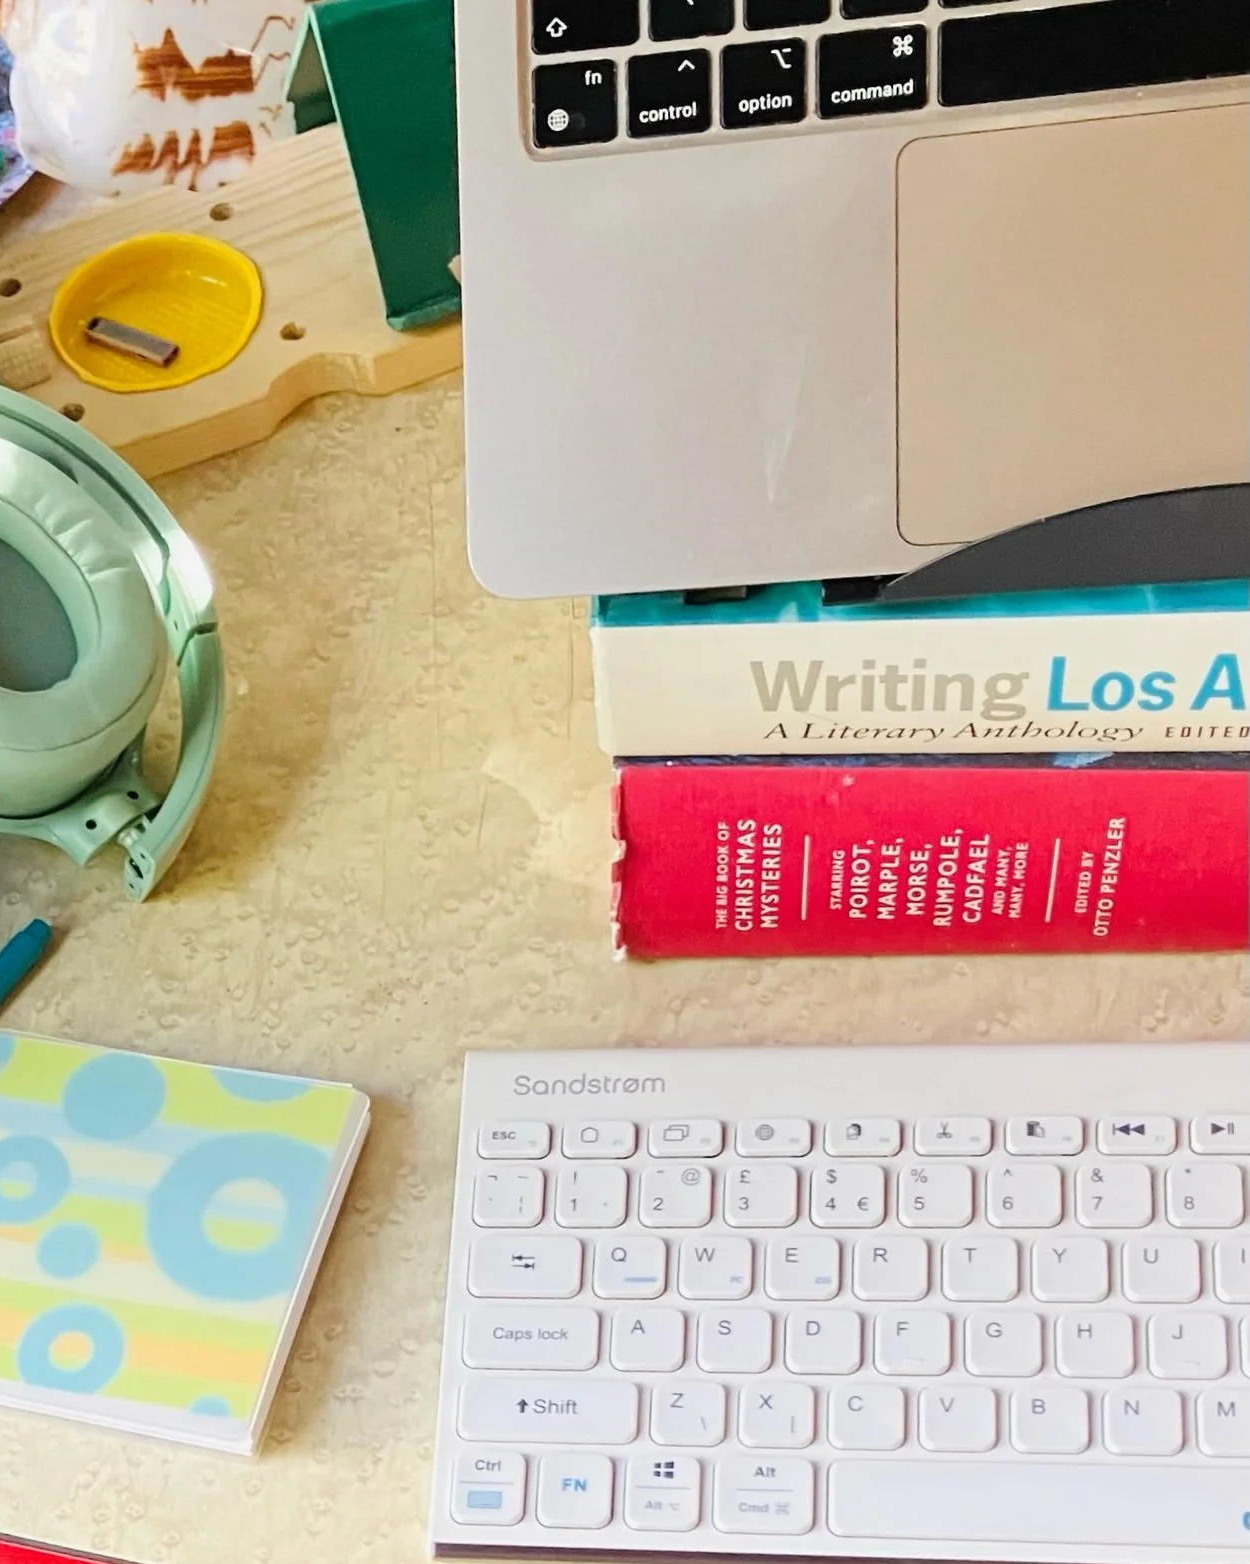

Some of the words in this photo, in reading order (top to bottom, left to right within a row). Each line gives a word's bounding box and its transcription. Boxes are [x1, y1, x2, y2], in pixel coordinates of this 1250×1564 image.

[584, 70, 602, 86] fn
[831, 79, 914, 104] command
[738, 93, 793, 115] option
[638, 102, 698, 124] control
[750, 658, 1030, 722] Writing
[1047, 656, 1176, 711] Los
[763, 722, 790, 739] A
[802, 721, 945, 743] Literary
[951, 720, 1144, 742] Anthology
[1165, 726, 1250, 738] EDITED
[717, 822, 730, 841] OF
[1013, 842, 1029, 880] MORE
[1081, 851, 1094, 868] BY
[1101, 817, 1126, 893] PENZLER
[717, 845, 729, 882] BOOK
[995, 846, 1012, 887] MANY,
[735, 819, 756, 931] CHRISTMAS
[760, 824, 782, 928] MYSTERIES
[830, 850, 846, 910] STARRING
[849, 840, 875, 919] POIROT,
[877, 838, 904, 919] MARPLE,
[906, 844, 933, 915] MORSE,
[933, 829, 964, 927] RUMPOLE,
[962, 834, 990, 923] CADFAEL
[716, 886, 729, 906] BIG
[1074, 871, 1092, 913] EDITED
[991, 890, 1006, 915] AND
[715, 909, 728, 929] THE
[1093, 899, 1114, 937] OTTO
[513, 1073, 666, 1096] Sandstrøm
[491, 1130, 516, 1140] ESC
[681, 1168, 701, 1186] @
[739, 1170, 751, 1184] £
[825, 1169, 838, 1184] $
[910, 1168, 928, 1184] %
[1090, 1168, 1104, 1183] &
[570, 1198, 577, 1211] 1
[653, 1197, 664, 1211] 2
[738, 1196, 750, 1211] 3
[825, 1196, 837, 1211] 4
[857, 1196, 870, 1211] €
[913, 1196, 925, 1211] 5
[1002, 1196, 1014, 1210] 6
[1092, 1196, 1103, 1210] 7
[1183, 1196, 1195, 1210] 8
[611, 1247, 628, 1263] Q
[694, 1247, 715, 1263] W
[785, 1248, 799, 1263] E
[872, 1248, 889, 1263] R
[963, 1248, 977, 1263] T
[1052, 1248, 1068, 1264] Y
[1143, 1249, 1159, 1264] U
[492, 1326, 533, 1342] Caps
[537, 1326, 568, 1341] lock
[630, 1320, 646, 1335] A
[717, 1320, 732, 1336] S
[806, 1321, 821, 1336] D
[896, 1322, 910, 1337] F
[985, 1321, 1003, 1338] G
[1077, 1323, 1093, 1339] H
[1172, 1324, 1184, 1340] J
[533, 1398, 578, 1415] Shift
[670, 1393, 685, 1409] Z
[758, 1393, 774, 1410] X
[847, 1396, 864, 1412] C
[939, 1398, 955, 1413] V
[1031, 1399, 1046, 1415] B
[1124, 1400, 1141, 1415] N
[1217, 1402, 1236, 1417] M
[474, 1459, 502, 1472] Ctrl
[753, 1466, 777, 1478] Alt
[561, 1478, 587, 1492] FN
[738, 1502, 769, 1513] Cmd
